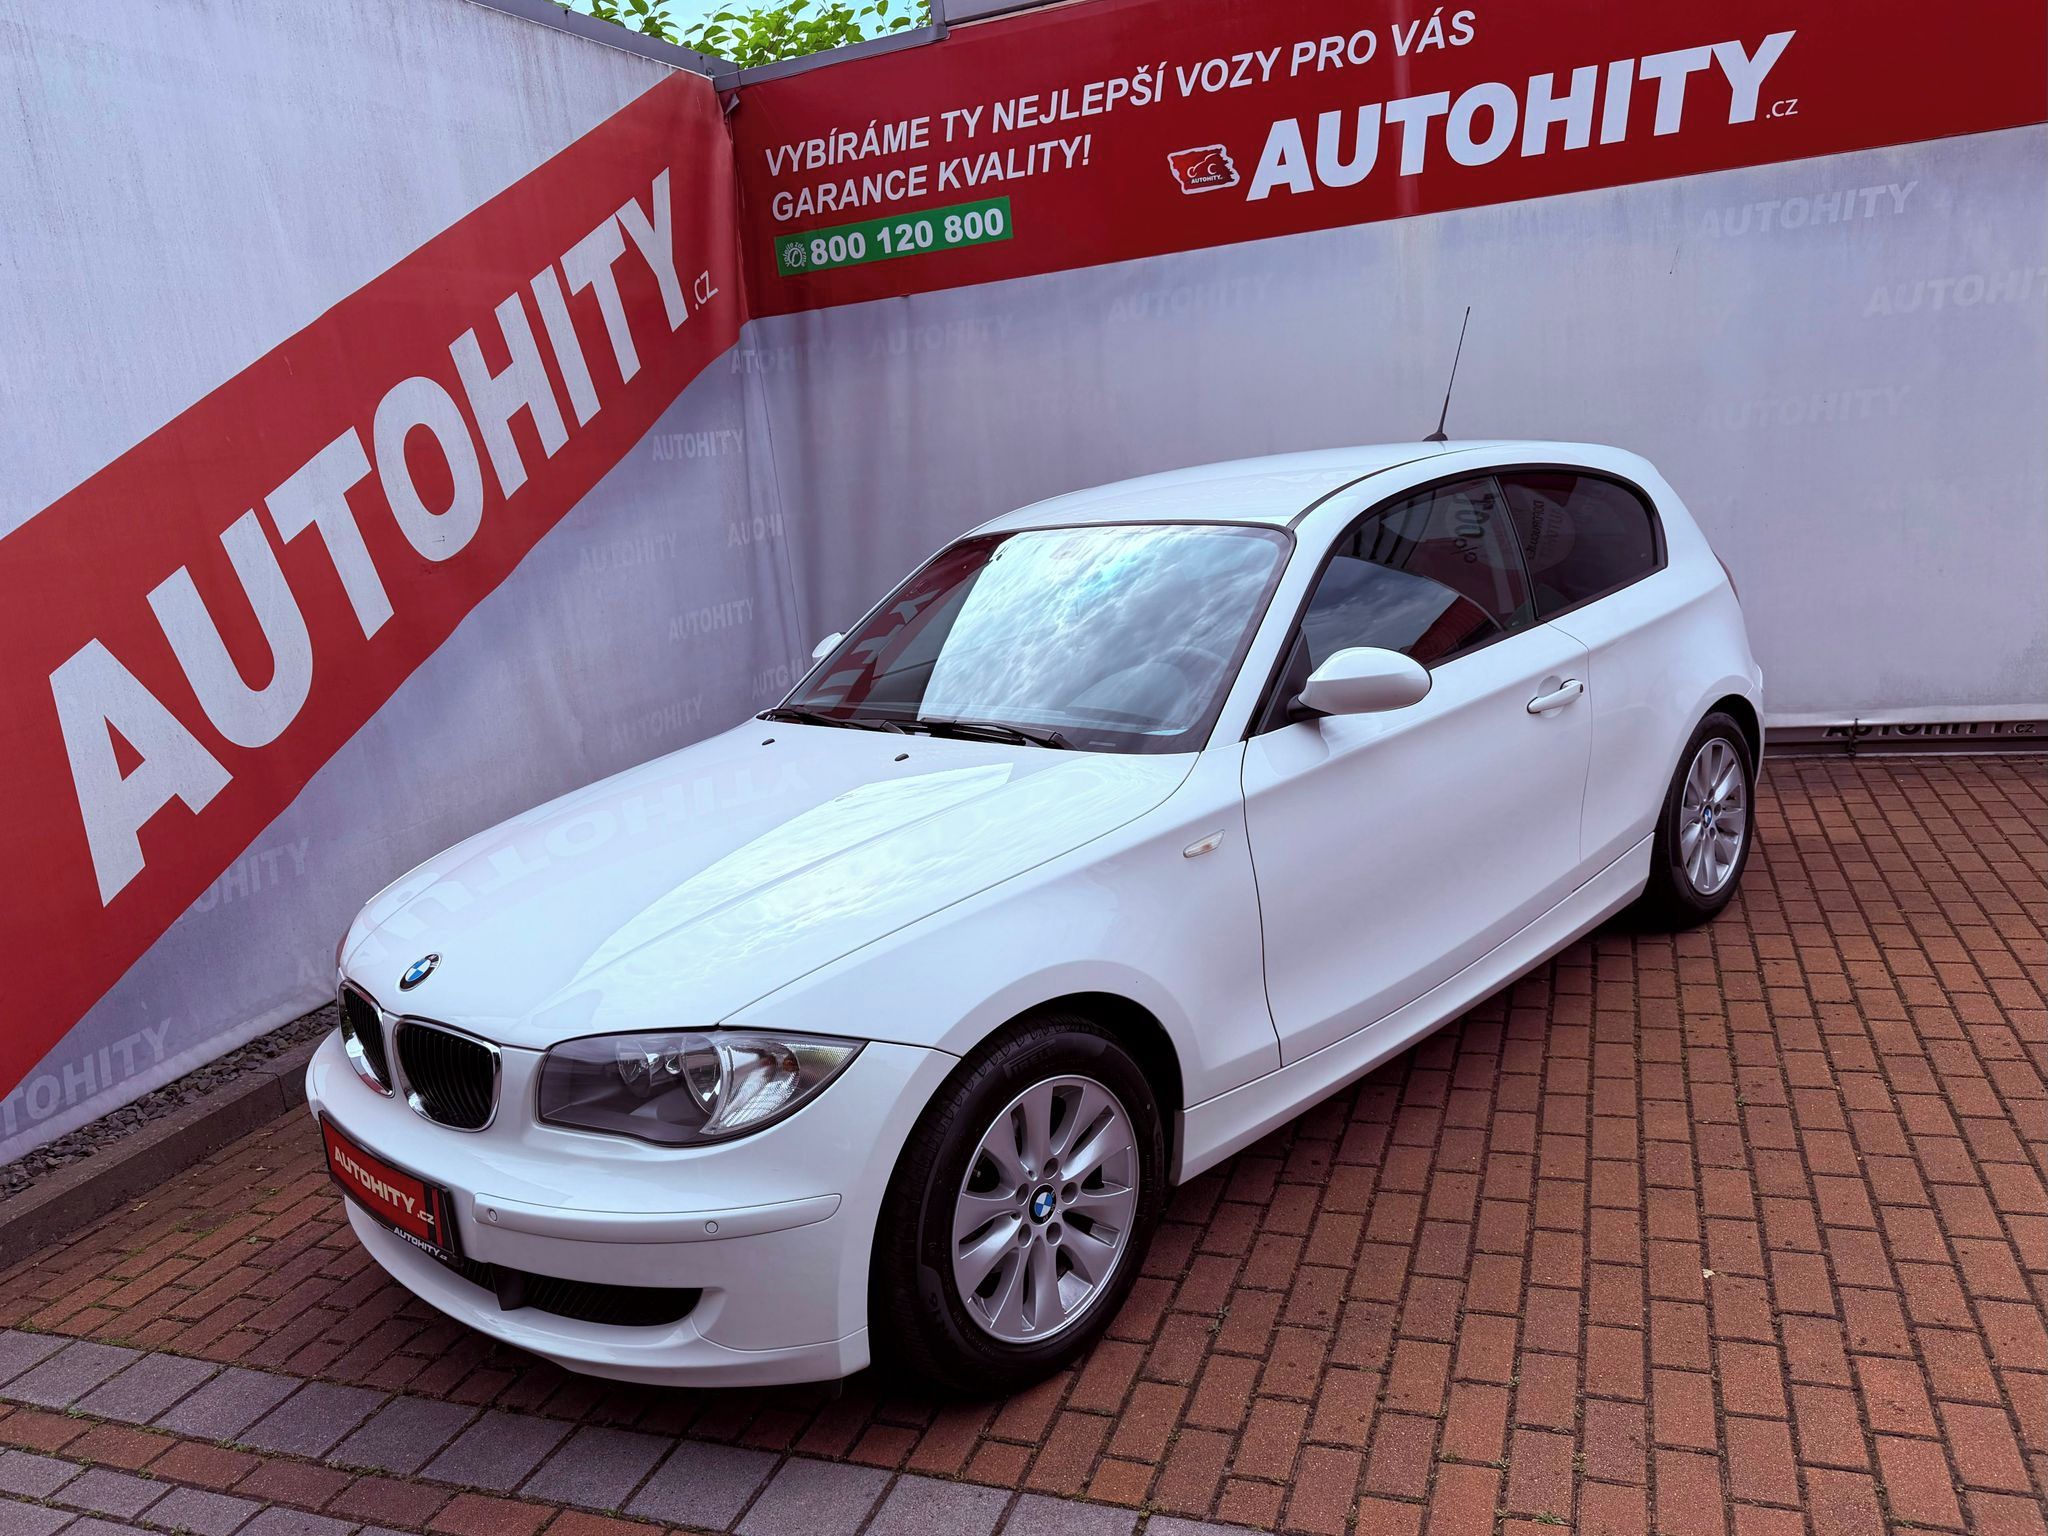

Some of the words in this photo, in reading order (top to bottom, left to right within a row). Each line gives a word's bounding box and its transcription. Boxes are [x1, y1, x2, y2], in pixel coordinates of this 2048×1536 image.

[765, 117, 929, 177] VYBÍRÁME
[941, 106, 985, 142] TY
[992, 61, 1165, 134] NEJLEPŠÍ
[1176, 47, 1281, 97] VOZY
[1290, 29, 1377, 76] PRO
[1392, 9, 1476, 57] VÁS
[772, 167, 926, 221] GARANCE
[938, 134, 1092, 192] KVALITY!
[810, 232, 866, 265] 800
[876, 220, 934, 254] 120
[944, 208, 1004, 243] 800
[652, 428, 744, 462] AUTOHITY
